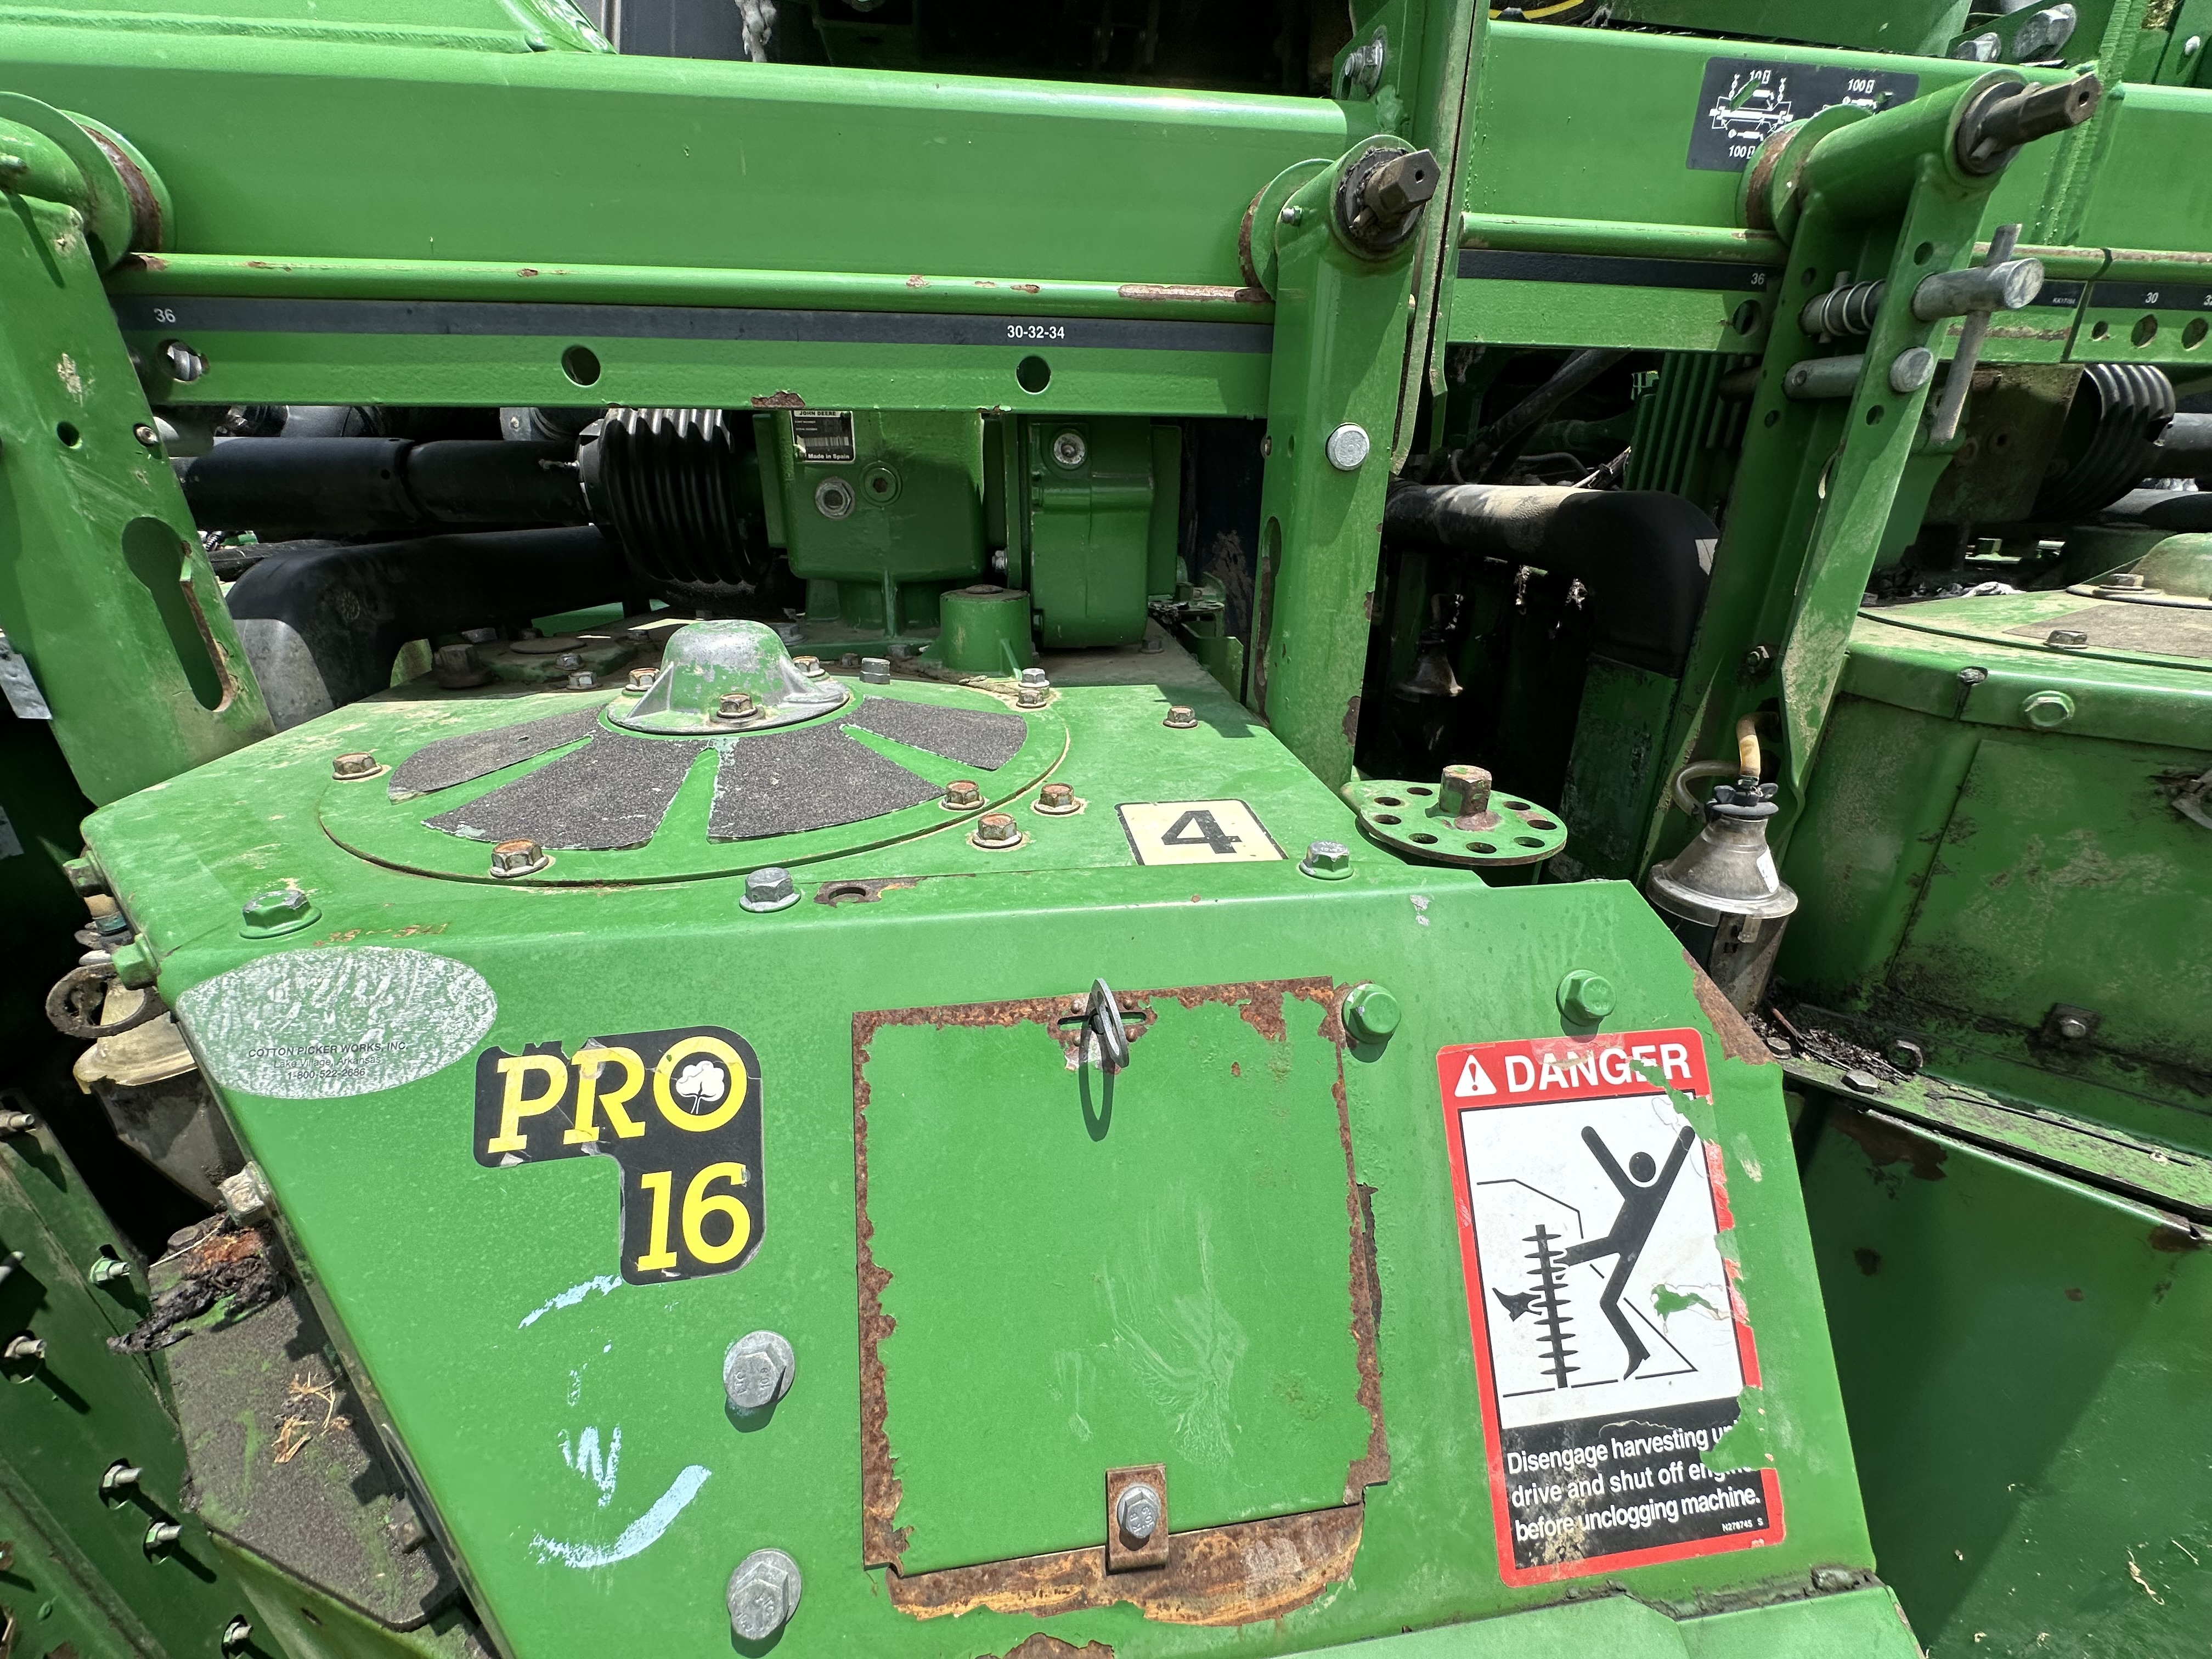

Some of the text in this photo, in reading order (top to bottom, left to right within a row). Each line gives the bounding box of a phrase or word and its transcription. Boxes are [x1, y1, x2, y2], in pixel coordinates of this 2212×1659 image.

[1848, 78, 1866, 92] 100
[1729, 145, 1746, 157] 100
[1751, 273, 1765, 285] 36
[2145, 292, 2159, 303] 30
[154, 308, 176, 323] 36
[1007, 325, 1065, 339] 30-32-34
[1161, 810, 1243, 854] 4
[249, 1047, 294, 1058] COTTON
[297, 1045, 338, 1056] PICKER
[387, 1042, 409, 1051] INC.
[274, 1059, 297, 1068] Lake
[338, 1056, 381, 1065] Arkansas
[1504, 1043, 1692, 1093] DANGER
[287, 1068, 366, 1080] 1-800-522-2686
[487, 1036, 747, 1153] PRO
[637, 1162, 750, 1272] 16
[1507, 1444, 1609, 1474] Disengage
[1611, 1427, 1709, 1459] harvesting
[1511, 1482, 1562, 1508] drive
[1567, 1473, 1605, 1499] and
[1610, 1466, 1655, 1493] shut
[1657, 1460, 1684, 1485] off
[1515, 1486, 1761, 1542] before unclogging machine.
